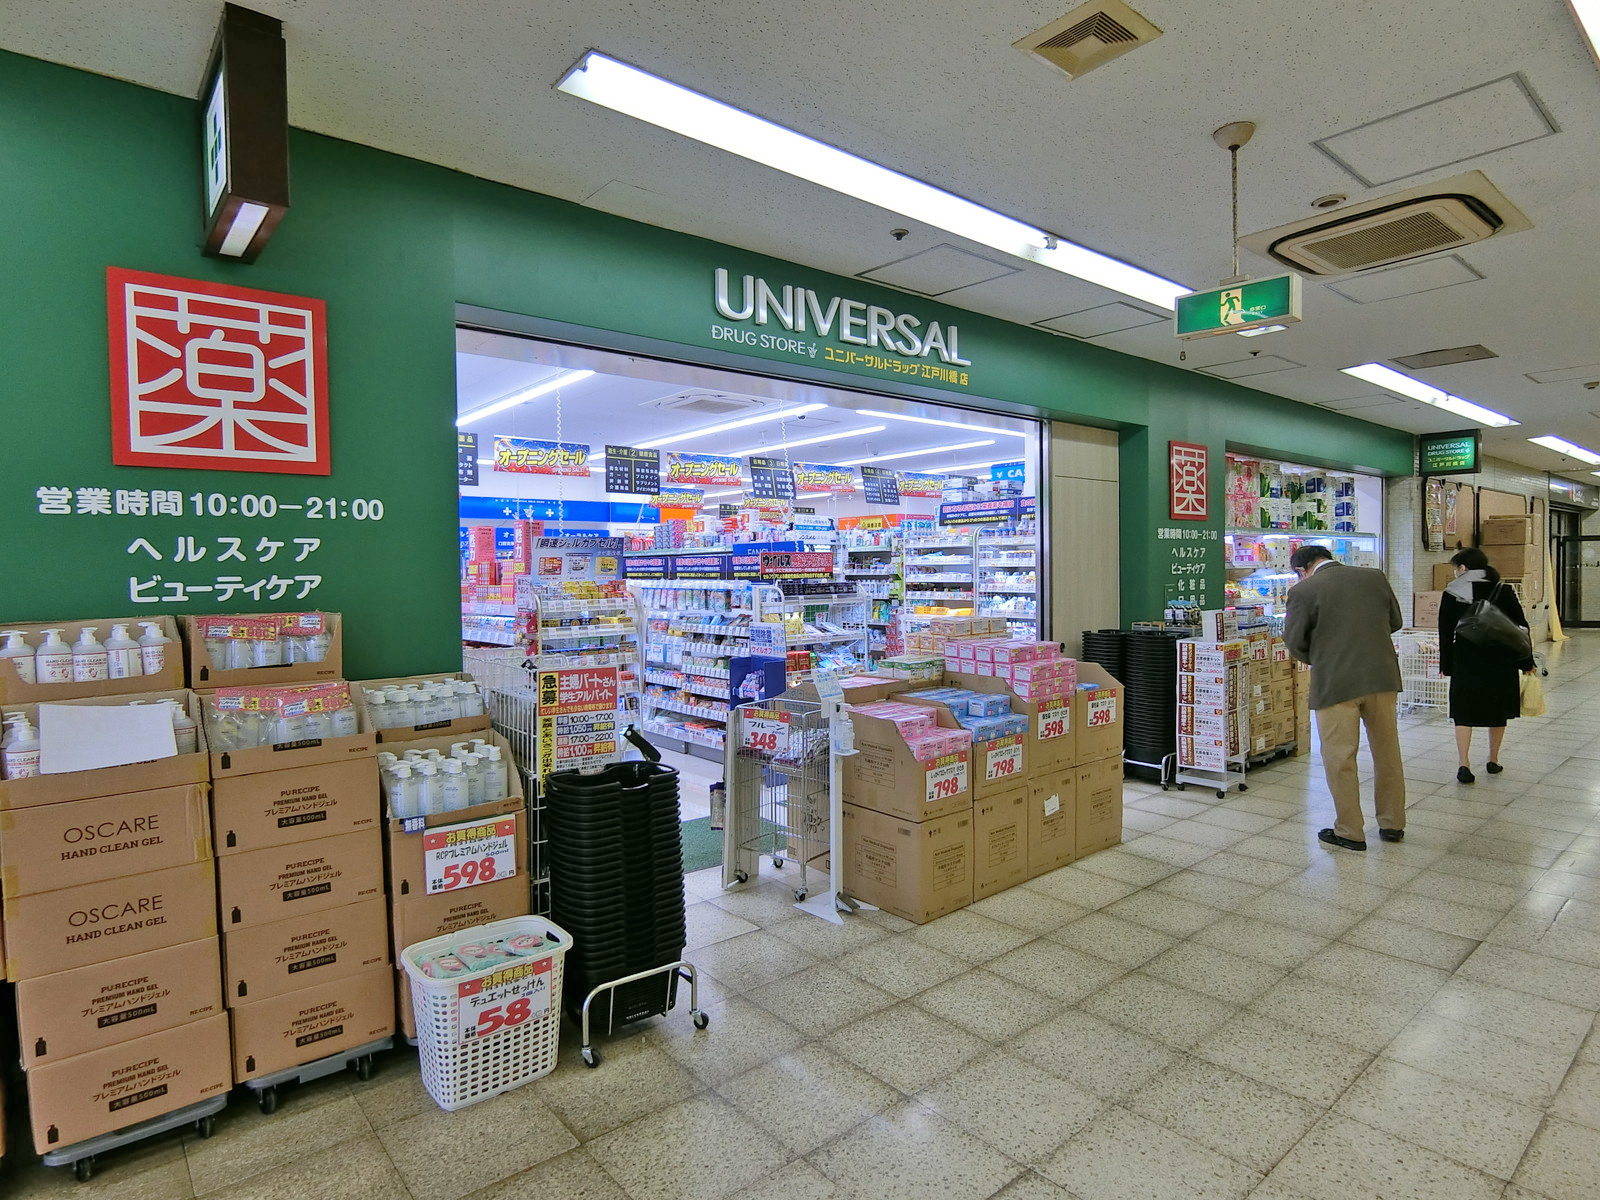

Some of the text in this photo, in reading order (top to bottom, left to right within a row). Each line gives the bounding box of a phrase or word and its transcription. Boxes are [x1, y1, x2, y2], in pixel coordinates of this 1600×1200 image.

[715, 267, 972, 367] UNIVERSAL
[711, 325, 806, 356] DRUG STORE
[824, 347, 919, 376] ユニバーサルドラッグ
[1427, 441, 1471, 451] UNIVERSAL
[499, 449, 586, 467] オープニングセール
[671, 462, 740, 479] オープニングセール
[797, 471, 852, 485] オープニングセール
[1007, 469, 1025, 478] CA
[899, 479, 943, 491] オープニングセール
[35, 486, 183, 516] 営業時間
[651, 493, 702, 505] オープニングセール
[1157, 527, 1182, 541] 営業時間
[126, 536, 321, 563] ヘルスケア
[1171, 547, 1206, 558] ヘルスケア
[1171, 563, 1206, 575] ビューティケア
[129, 574, 323, 603] ビューティケア
[1177, 578, 1206, 592] 化粧品
[541, 674, 558, 706] 急募
[559, 673, 616, 691] 主婦パートさん
[559, 689, 613, 704] 学生アルバイト
[1093, 708, 1111, 725] 598
[1044, 719, 1064, 738] 598
[750, 731, 777, 750] 348
[992, 757, 1015, 778] 798
[933, 776, 959, 801] 798
[264, 799, 338, 817] プレミアムハンドジェル
[63, 814, 160, 844] OSCARE
[404, 817, 425, 832] 無香料
[445, 824, 497, 844] お買得商品
[60, 835, 164, 861] HAND CLEAN GEL
[436, 839, 508, 861] RCPプレミアムハンドジェル
[269, 870, 343, 891] プレミアムハンドジェル
[443, 856, 497, 890] 598
[68, 894, 163, 927] OSCARE
[65, 916, 168, 945] HAND CLEAN GEL
[436, 913, 497, 933] プレミアムハンドジェル
[274, 940, 348, 964] プレミアムハンドジェル
[480, 963, 534, 988] お買得商品
[81, 988, 171, 1018] プレミアムハンドジェル
[91, 991, 126, 1005] PREMIUM
[470, 977, 545, 1008] デュエットせっけん
[282, 1012, 355, 1039] プレミアムハンドジェル
[476, 997, 531, 1038] 58
[92, 1069, 182, 1102] プレミアムハンドジェル
[102, 1072, 136, 1089] PREMIUM
